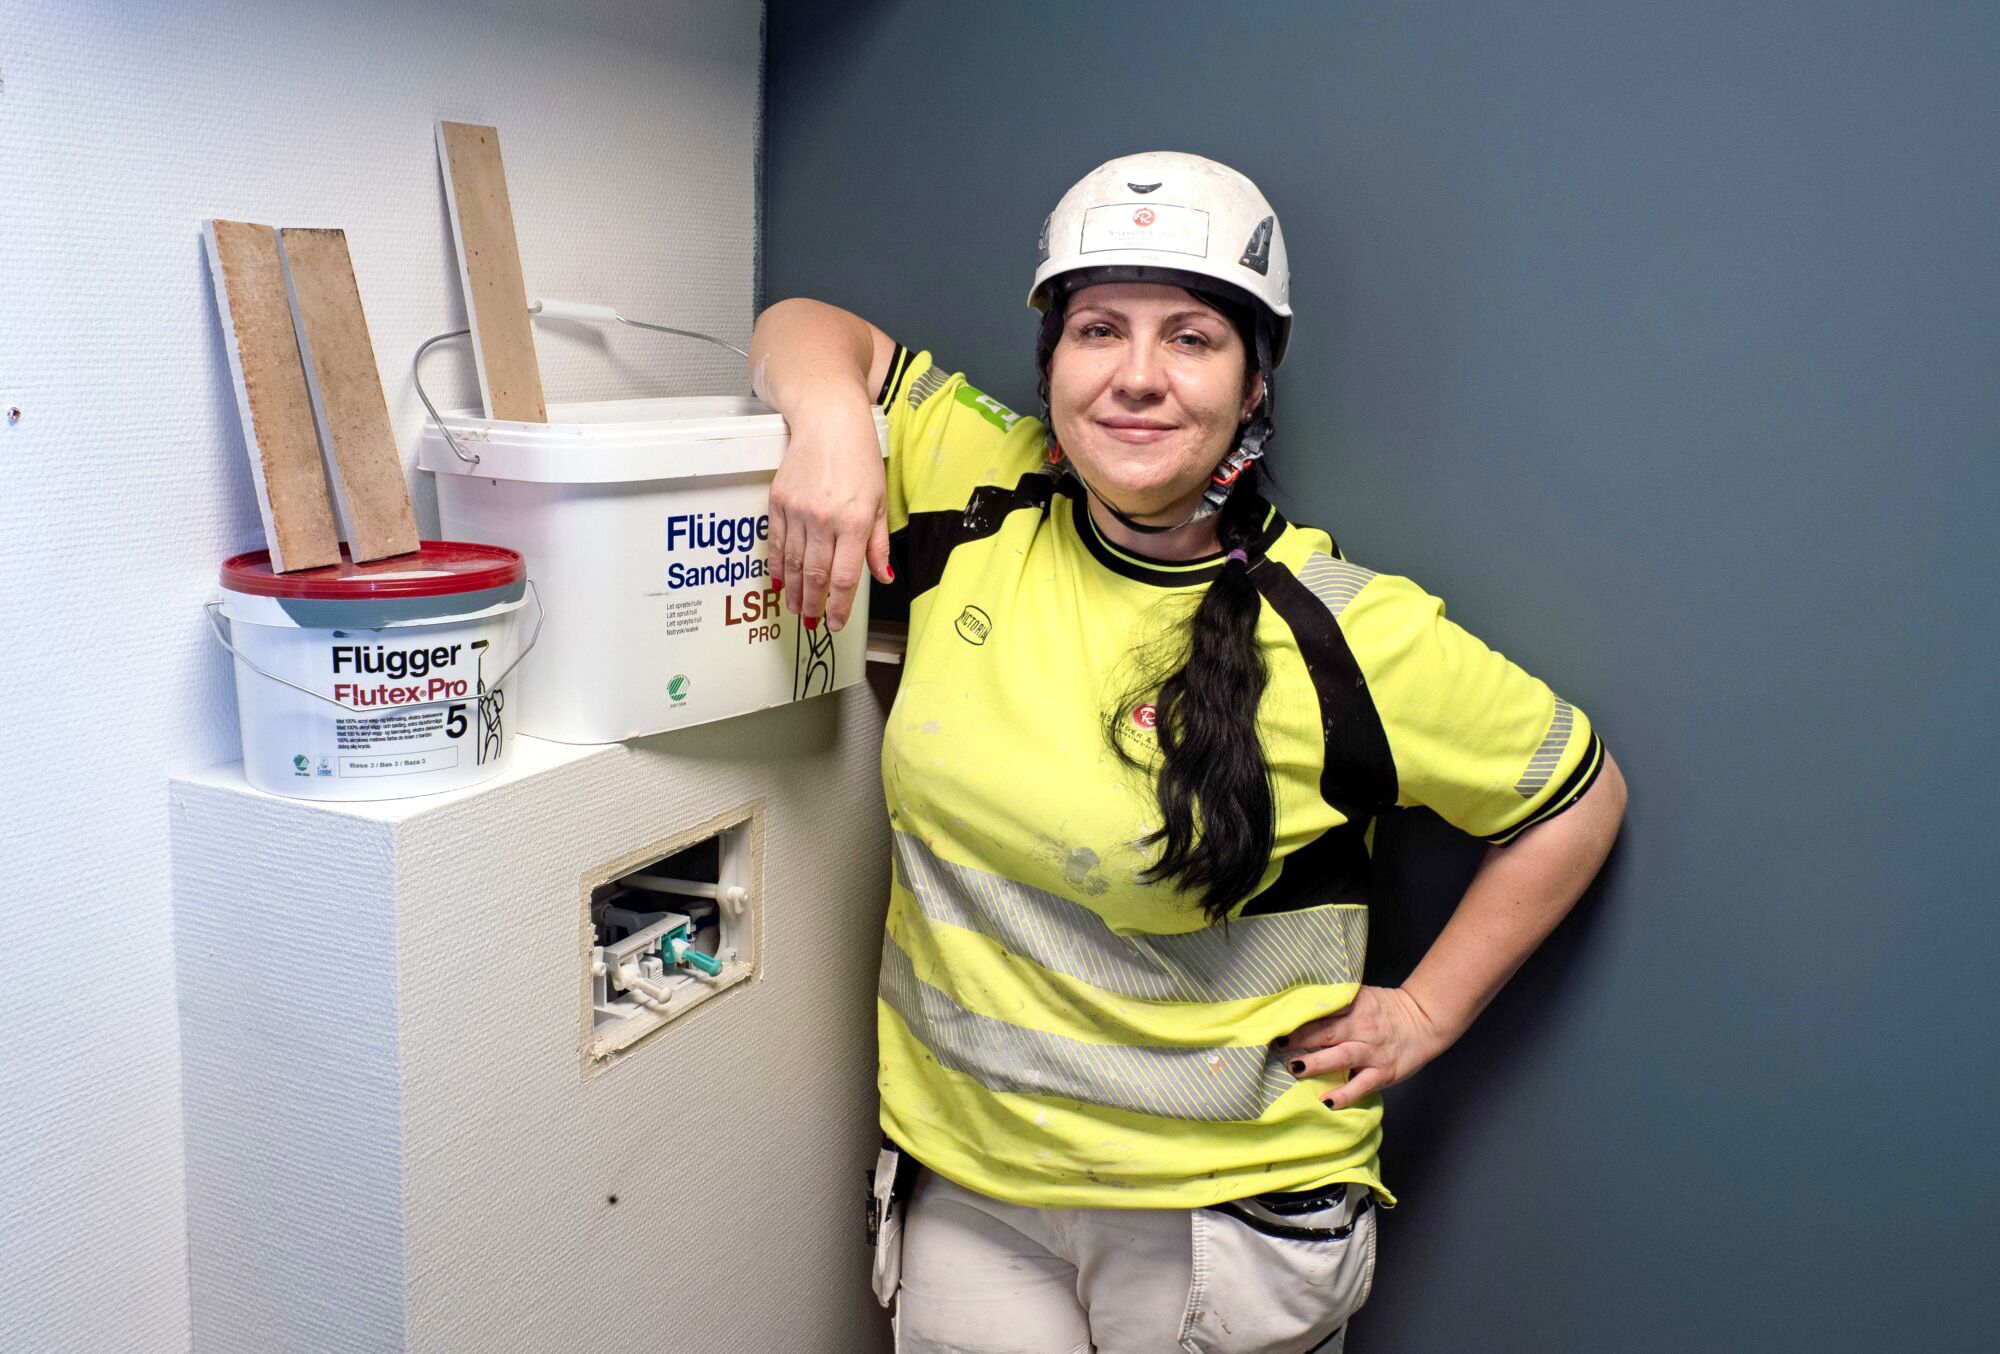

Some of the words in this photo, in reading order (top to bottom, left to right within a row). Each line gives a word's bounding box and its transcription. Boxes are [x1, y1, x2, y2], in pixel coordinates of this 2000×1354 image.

[666, 512, 769, 555] Flügge
[667, 555, 770, 589] Sandplas
[725, 588, 781, 626] LSR
[749, 624, 781, 644] PRO
[332, 644, 462, 680] Flügger
[446, 703, 468, 739] 5
